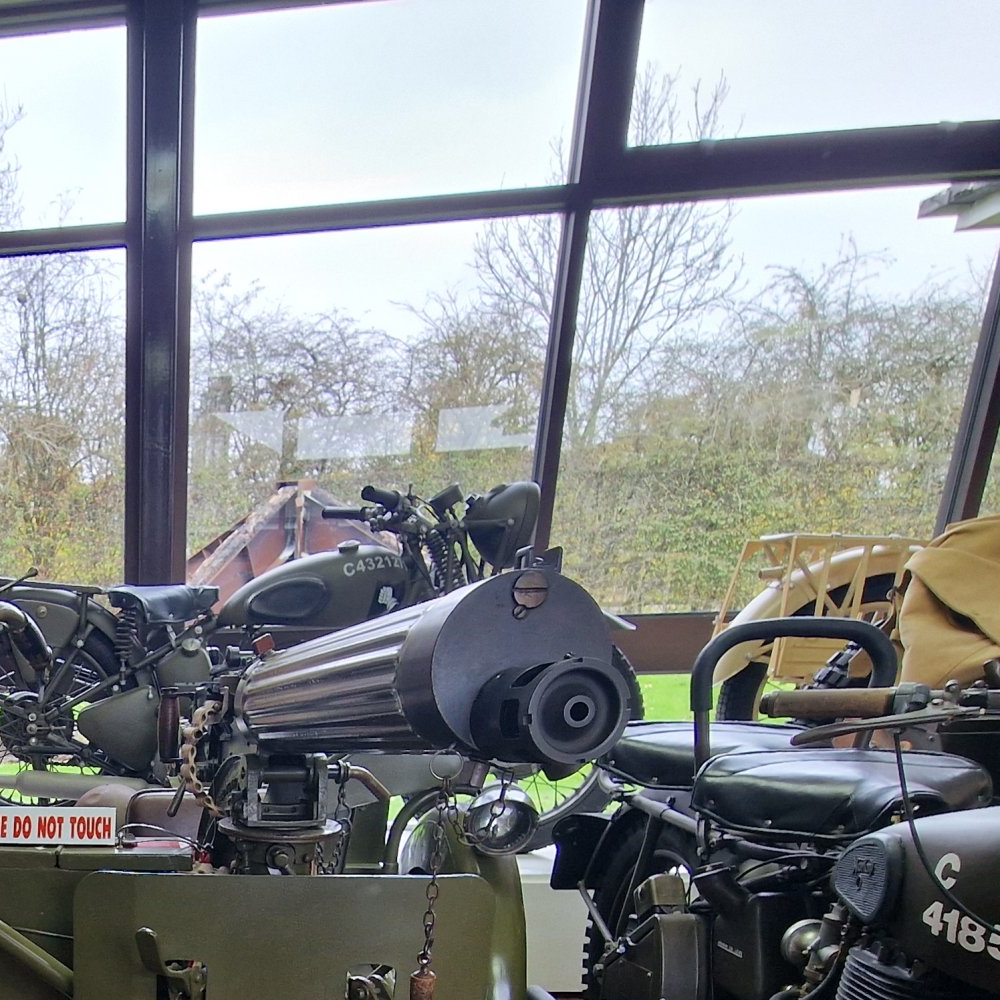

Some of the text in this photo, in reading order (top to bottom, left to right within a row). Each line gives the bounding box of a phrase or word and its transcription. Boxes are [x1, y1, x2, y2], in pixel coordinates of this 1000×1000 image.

[13, 815, 31, 839] DO
[37, 816, 64, 839] NOT
[70, 816, 112, 840] TOUCH
[934, 852, 961, 890] C
